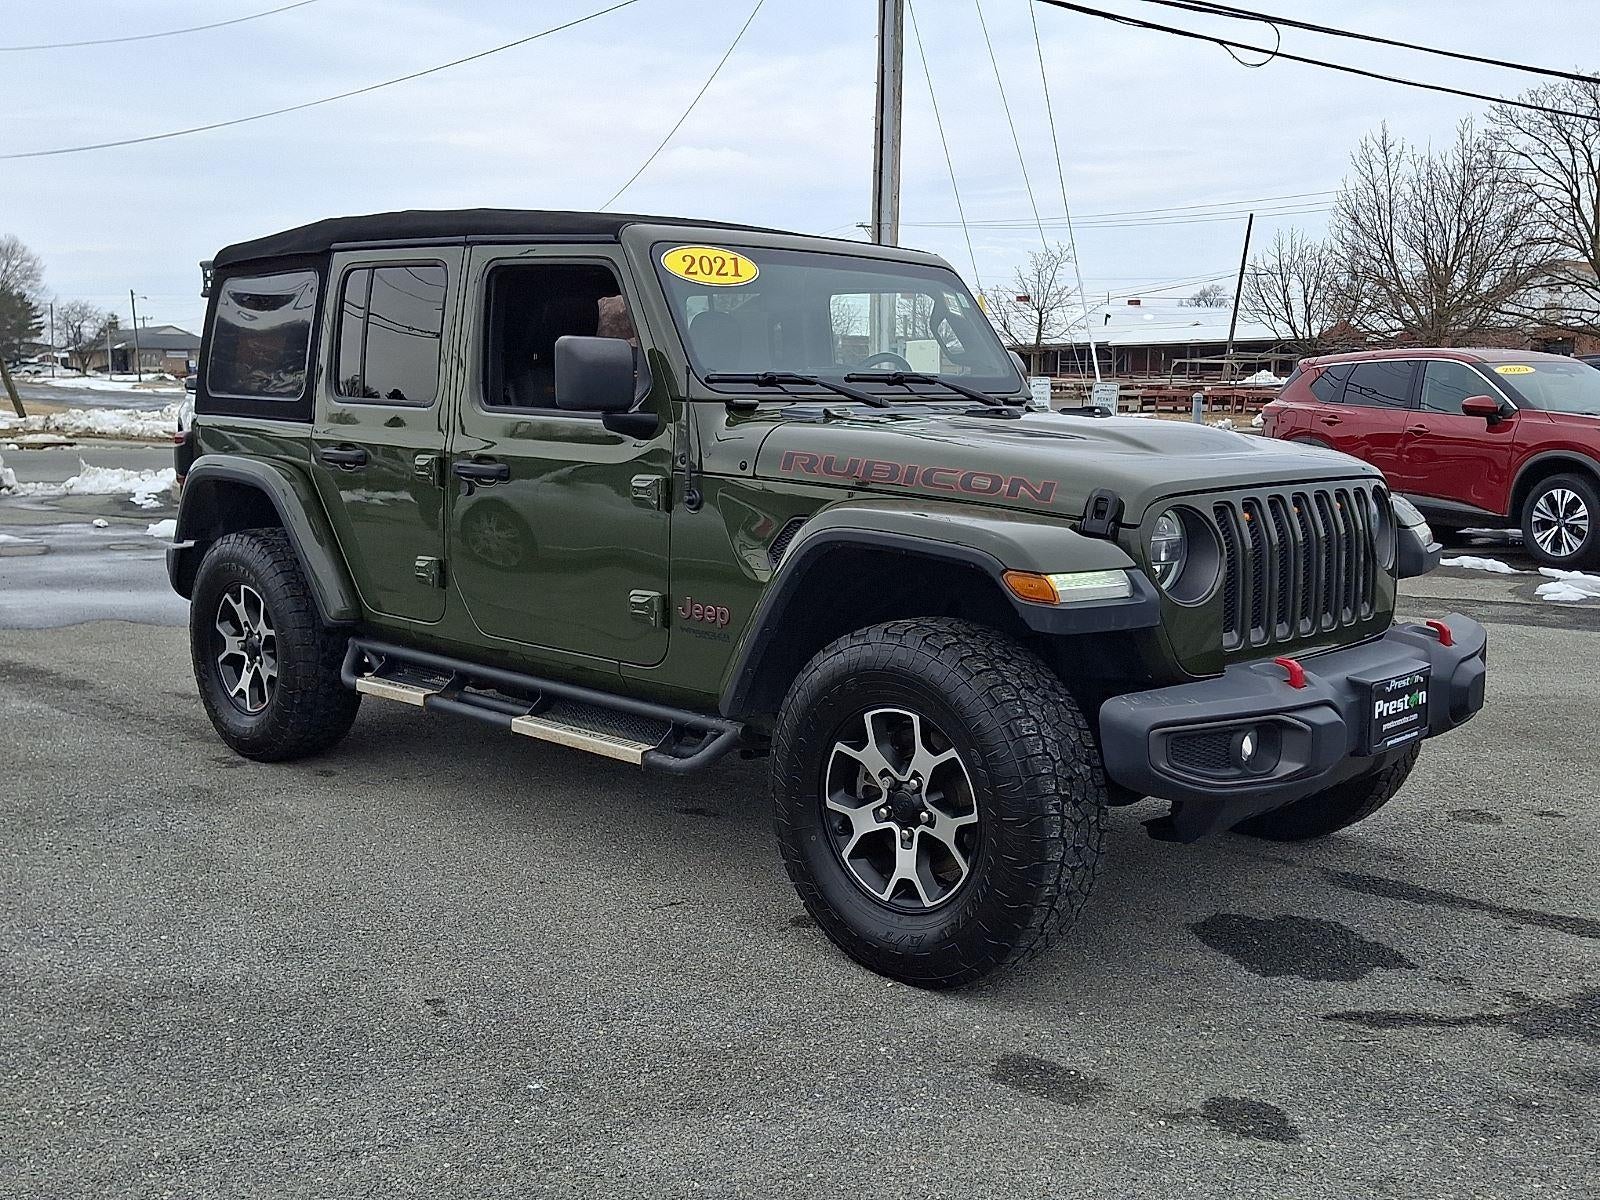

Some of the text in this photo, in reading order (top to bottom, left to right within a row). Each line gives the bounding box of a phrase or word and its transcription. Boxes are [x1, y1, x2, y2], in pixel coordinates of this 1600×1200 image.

[682, 254, 743, 278] 2021
[779, 450, 1058, 504] RUBICON
[677, 596, 730, 629] Jeep
[1374, 690, 1427, 720] Preston
